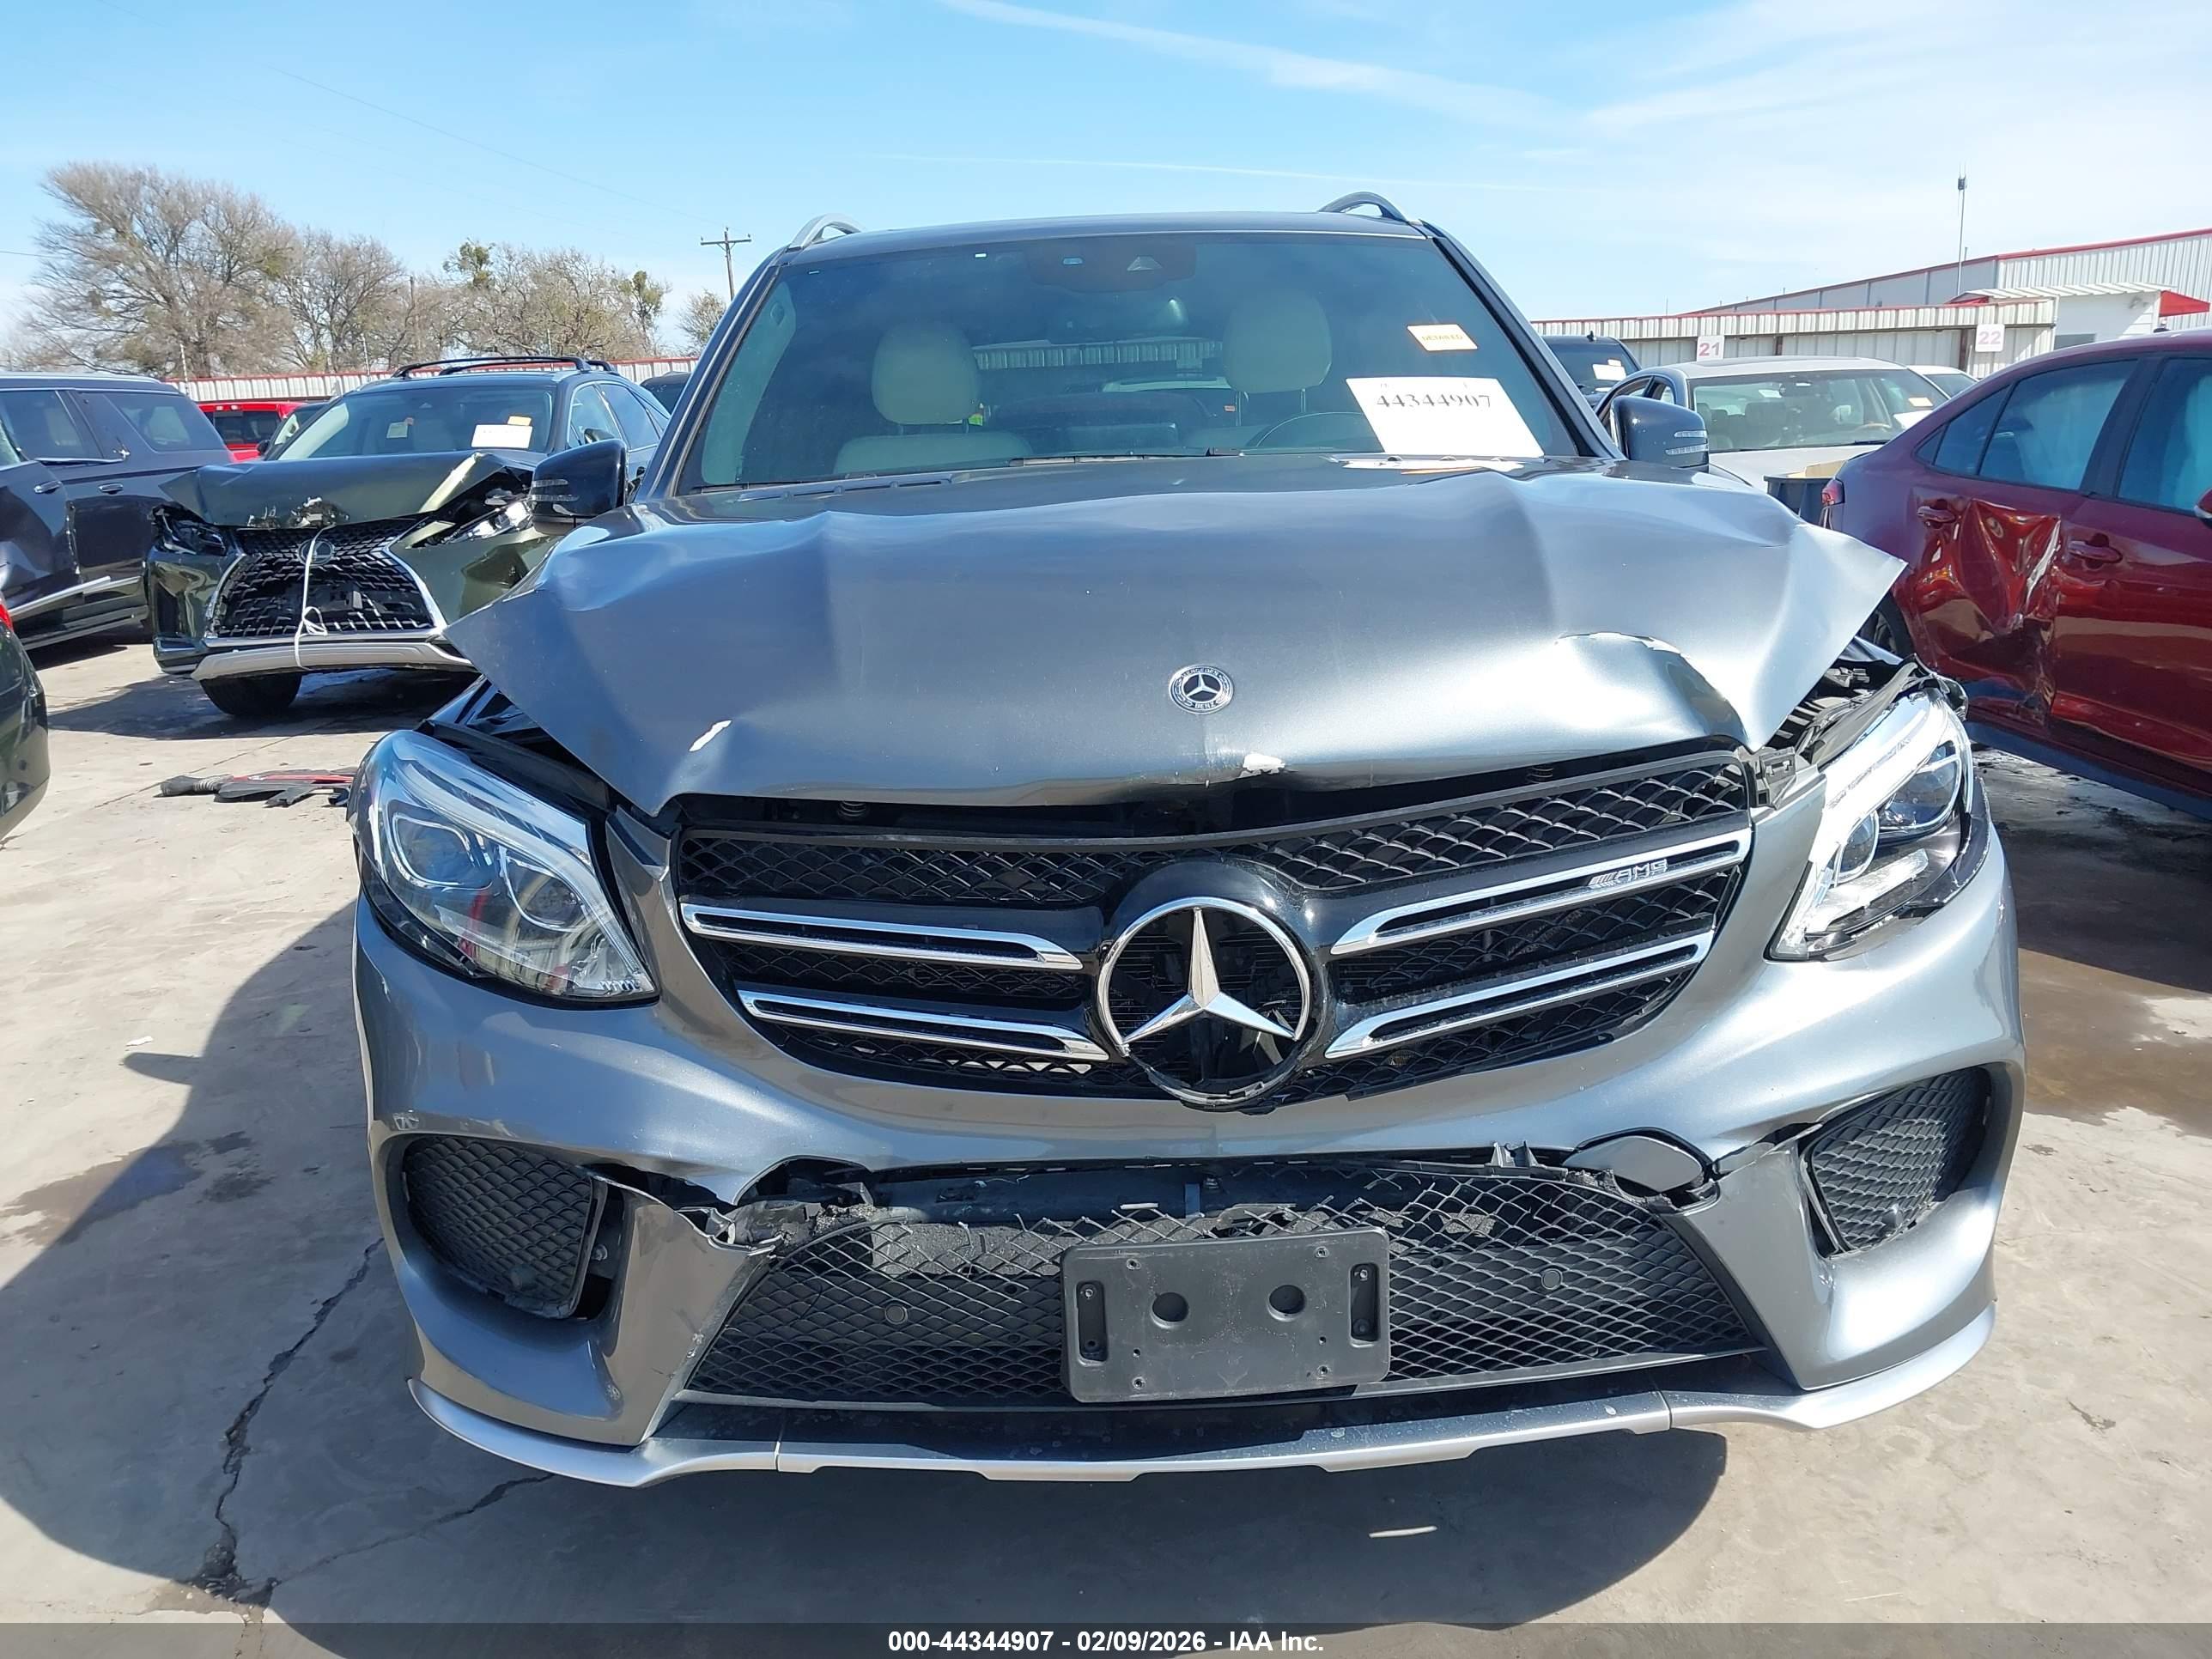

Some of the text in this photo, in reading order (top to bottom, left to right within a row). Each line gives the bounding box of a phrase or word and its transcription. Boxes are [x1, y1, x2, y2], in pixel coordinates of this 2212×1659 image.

[1978, 331, 2002, 344] 22
[1698, 342, 1720, 356] 21
[1376, 394, 1491, 407] 44344907
